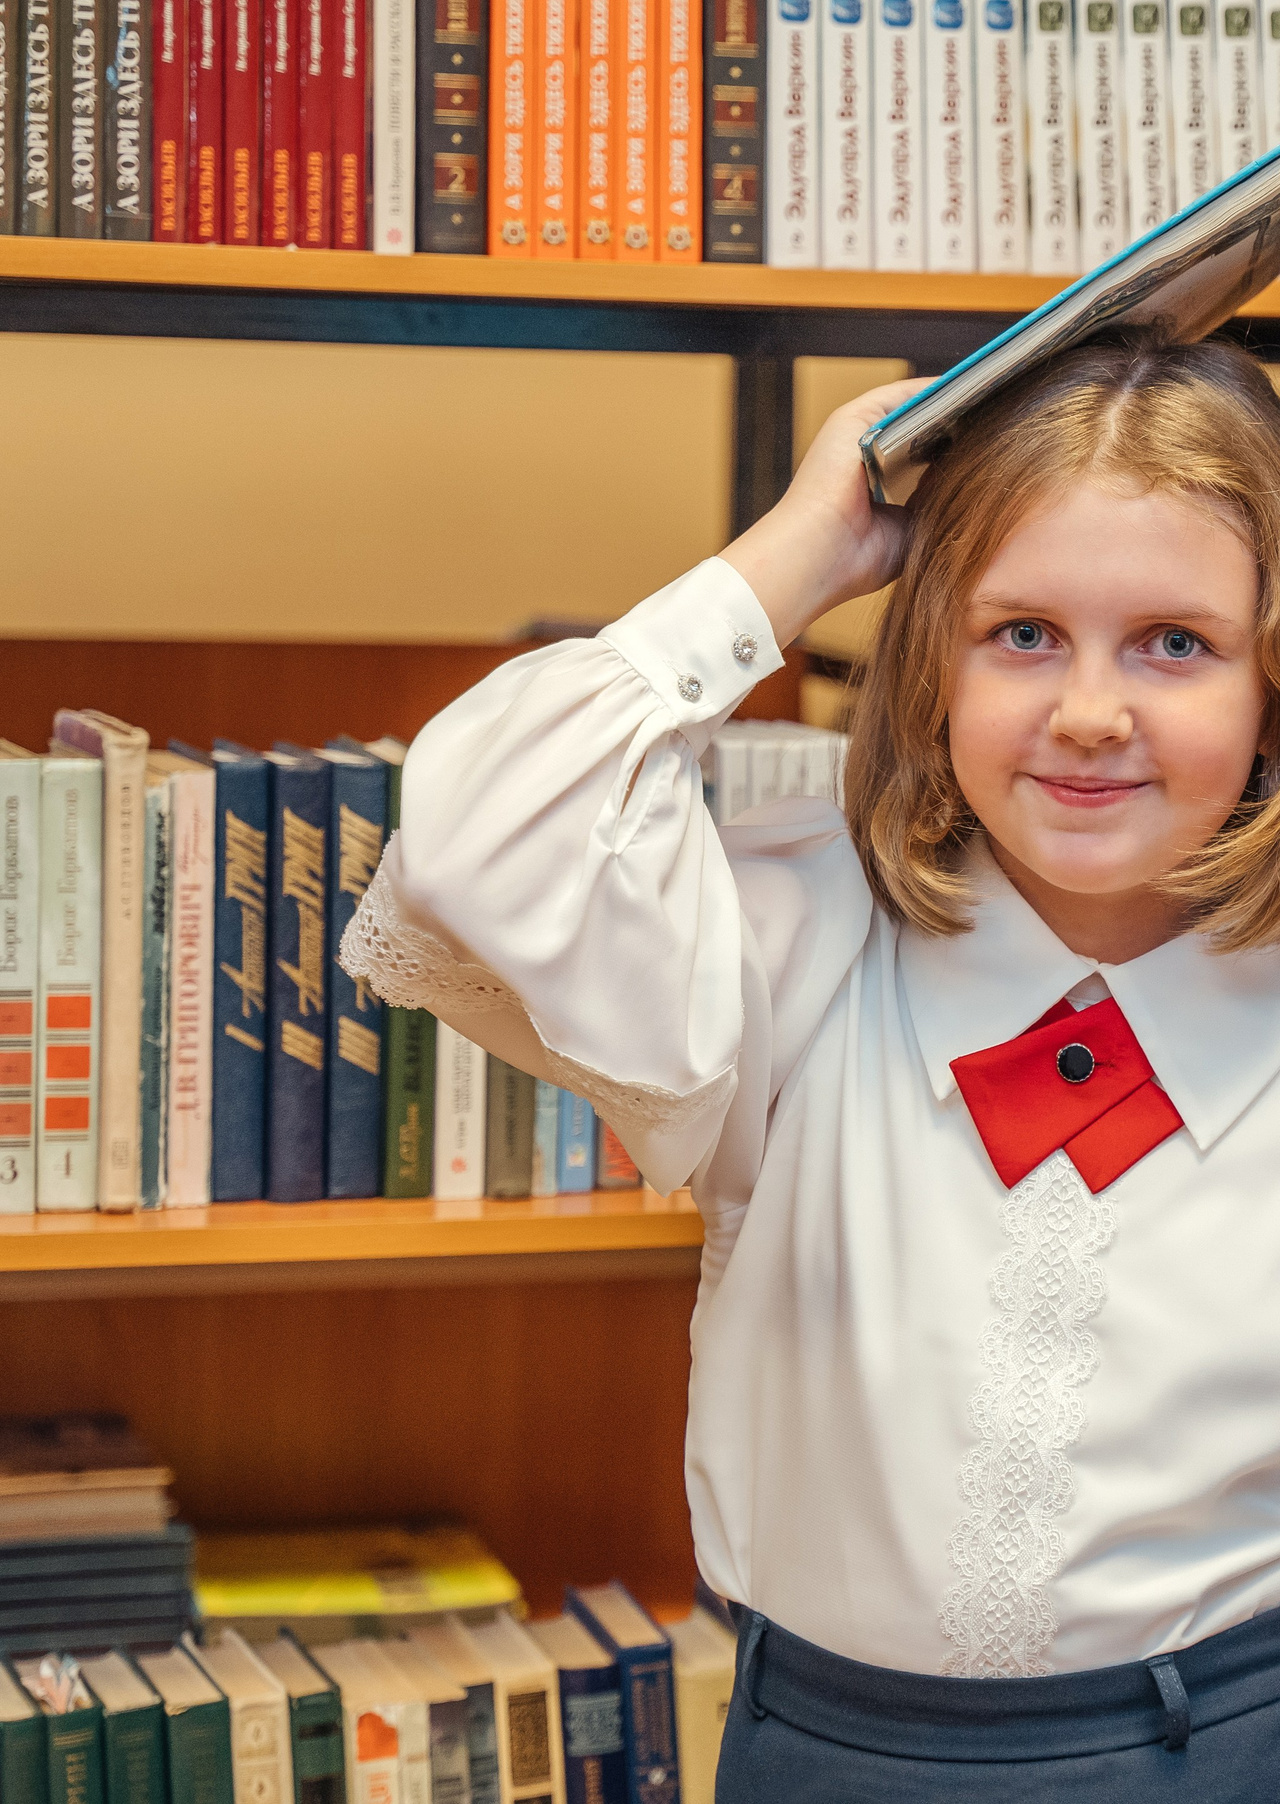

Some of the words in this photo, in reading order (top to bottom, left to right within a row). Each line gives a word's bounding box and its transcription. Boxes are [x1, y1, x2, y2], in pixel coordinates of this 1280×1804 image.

[26, 24, 52, 109] ЗДЕСЬ
[71, 28, 98, 114] ЗДЕСЬ
[115, 31, 144, 116] ЗДЕСЬ
[505, 60, 526, 129] ЗДЕСЬ
[545, 60, 566, 129] ЗДЕСЬ
[589, 60, 610, 129] ЗДЕСЬ
[627, 65, 648, 134] ЗДЕСЬ
[669, 66, 690, 135] ЗДЕСЬ
[26, 112, 49, 185] ЗОРИ
[71, 116, 94, 190] ЗОРИ
[115, 118, 140, 191] ЗОРИ
[505, 133, 524, 190] ЗОРИ
[545, 133, 564, 190] ЗОРИ
[589, 132, 608, 190] ЗОРИ
[627, 137, 646, 195] ЗОРИ
[669, 139, 688, 197] ЗОРИ
[27, 188, 49, 208] А
[72, 192, 94, 212] А
[116, 194, 140, 214] А
[449, 165, 466, 192] 2
[504, 193, 523, 210] А
[544, 193, 563, 210] А
[588, 193, 607, 210] А
[626, 198, 645, 215] А
[723, 177, 743, 199] 4
[668, 200, 687, 216] А
[176, 884, 202, 1065] ГРИГОРОВИЧ
[0, 1155, 18, 1185] 3
